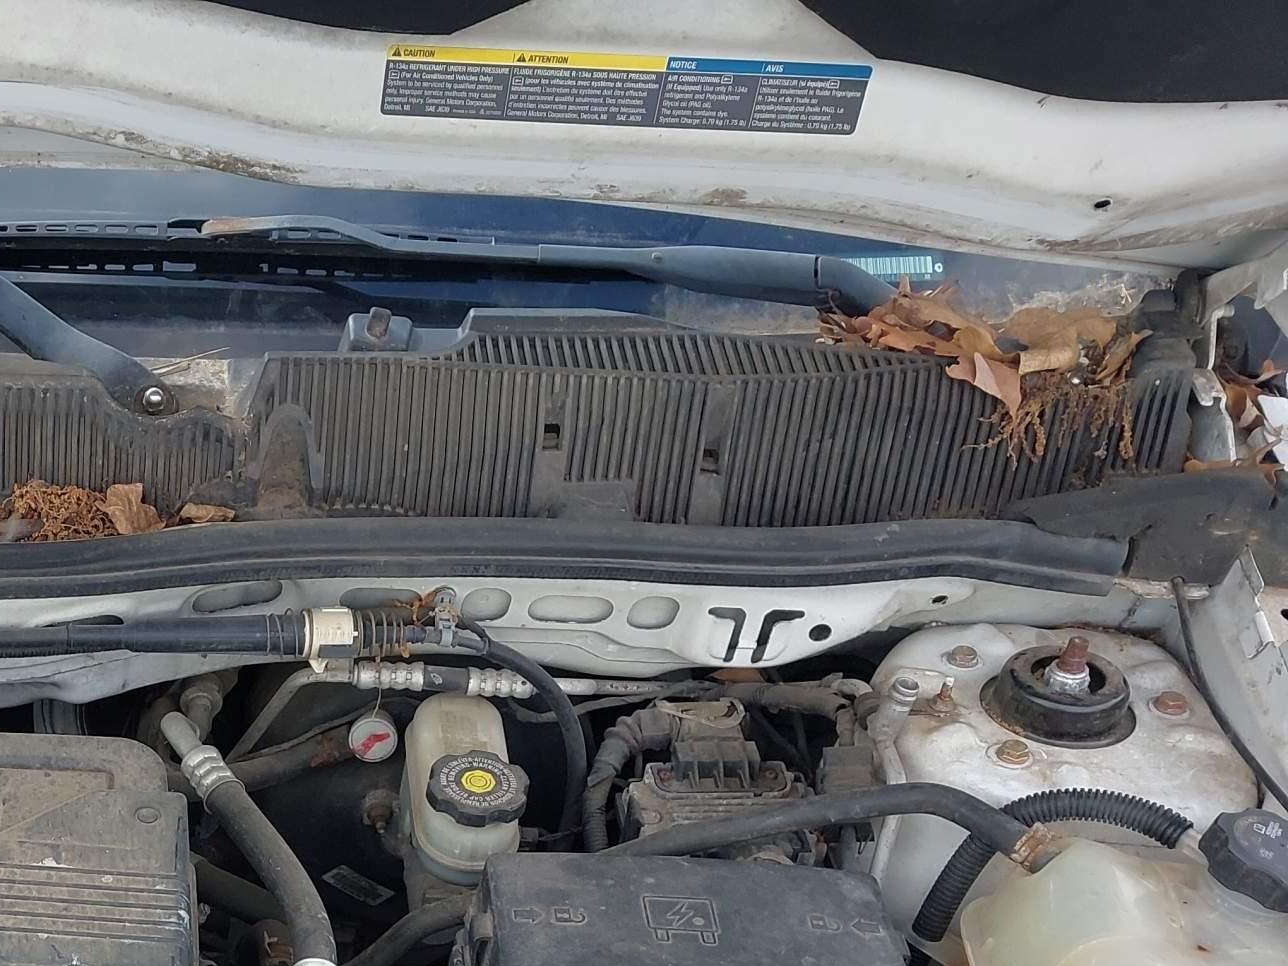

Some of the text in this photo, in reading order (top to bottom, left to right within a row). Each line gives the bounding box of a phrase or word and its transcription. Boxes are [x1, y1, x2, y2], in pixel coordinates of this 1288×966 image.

[403, 48, 435, 57] CAUTION
[528, 54, 568, 63] ATTENTION
[669, 60, 697, 68] NOTICE
[765, 64, 783, 72] AVIS
